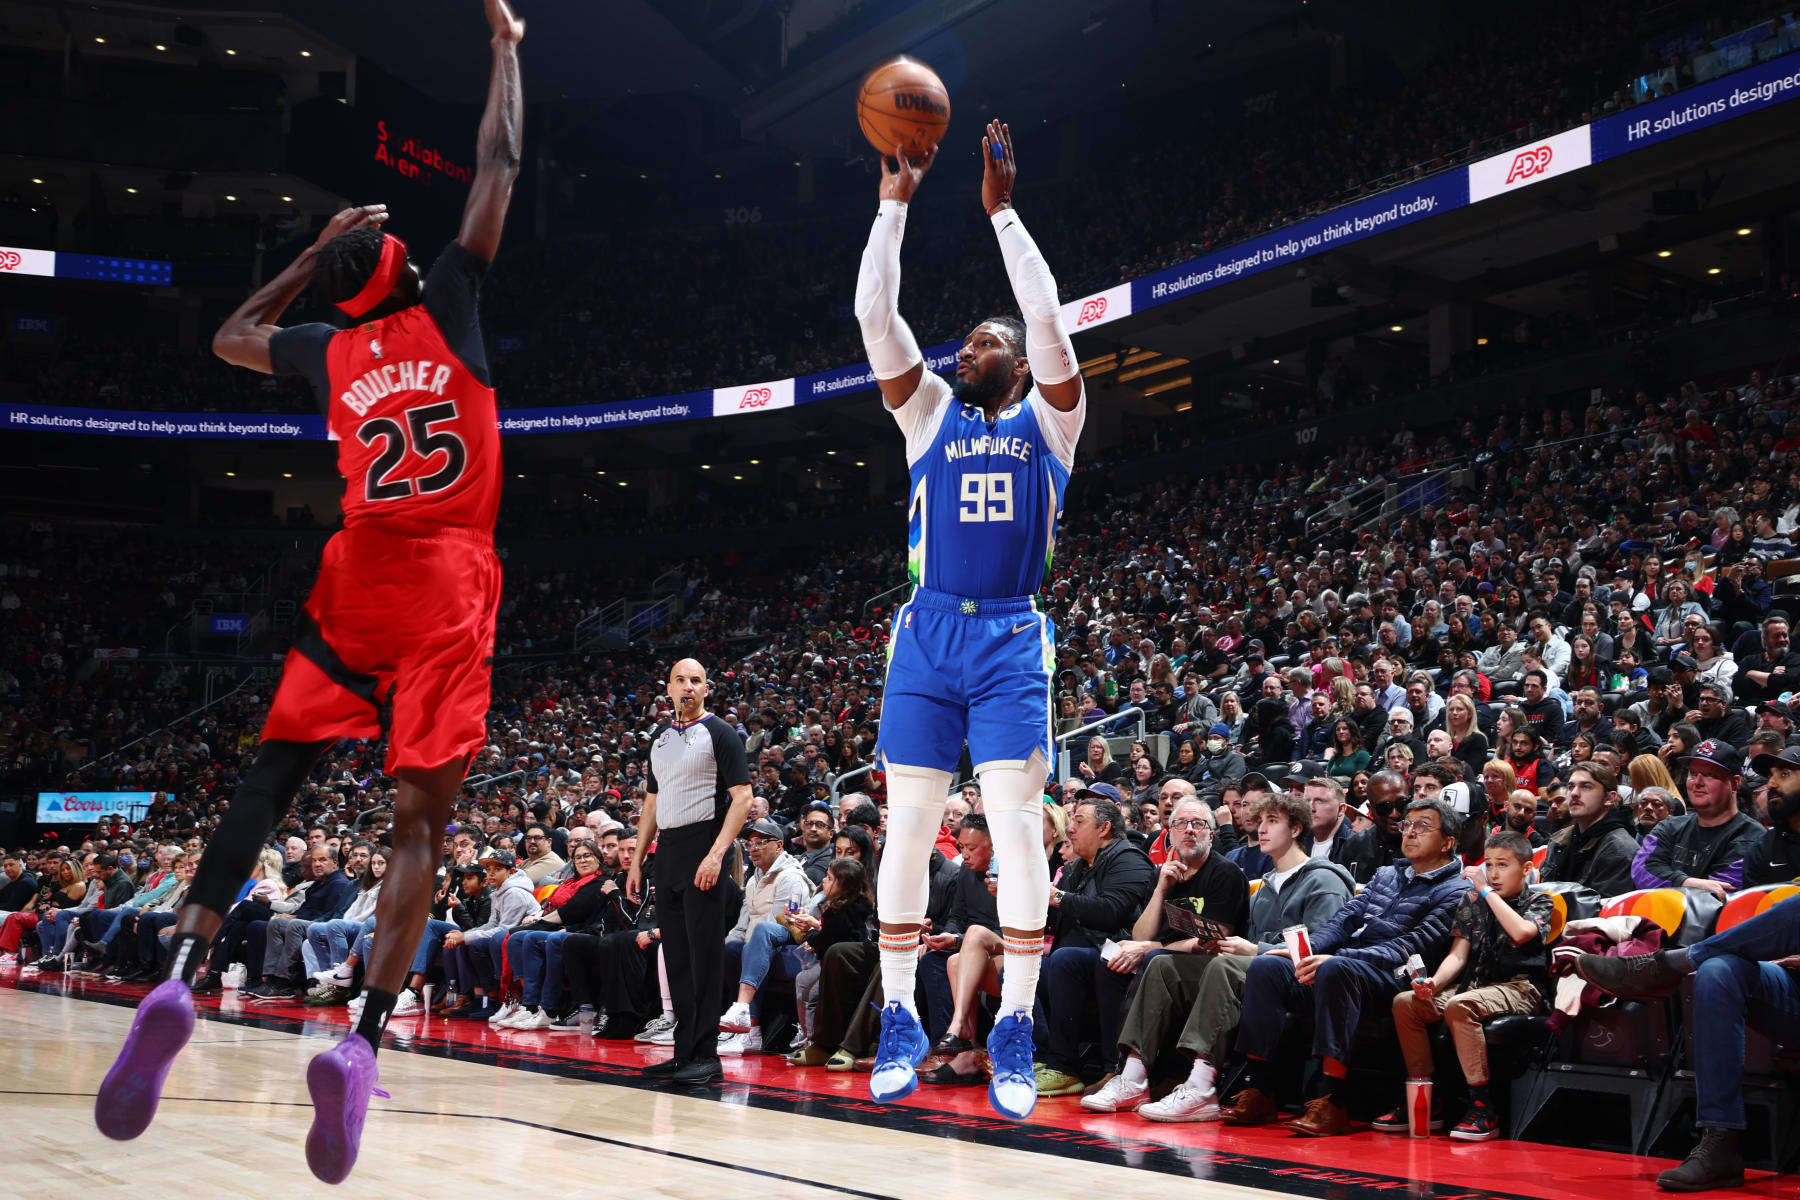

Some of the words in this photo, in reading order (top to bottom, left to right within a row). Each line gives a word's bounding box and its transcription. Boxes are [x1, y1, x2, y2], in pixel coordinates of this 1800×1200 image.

[1628, 119, 1651, 142] HR
[1654, 98, 1727, 133] solutions
[1505, 145, 1553, 185] ADP
[723, 206, 762, 225] 306
[1152, 282, 1168, 299] HR
[1168, 270, 1214, 294] solutions
[1214, 250, 1260, 275] designed
[1262, 249, 1274, 262] to
[1275, 239, 1299, 257] help
[1300, 234, 1321, 253] you
[1323, 220, 1352, 242] think
[1354, 203, 1398, 231] beyond
[1400, 195, 1438, 217] today.
[1077, 296, 1108, 326] ADP
[18, 318, 48, 333] IBM
[937, 354, 955, 369] you
[341, 360, 452, 418] BOUCHER
[812, 381, 826, 394] HR
[827, 371, 865, 391] solutions
[739, 387, 772, 409] ADP
[10, 411, 29, 424] HR
[30, 413, 84, 428] solutions
[85, 416, 136, 433] designed
[137, 420, 150, 431] to
[151, 420, 176, 435] help
[176, 423, 197, 435] you
[199, 421, 227, 433] think
[228, 421, 268, 435] beyond
[269, 422, 303, 436] today.
[504, 415, 549, 431] designed
[550, 416, 561, 427] to
[562, 414, 584, 428] help
[584, 414, 602, 427] you
[603, 409, 628, 422] think
[628, 405, 661, 422] beyond
[662, 403, 691, 417] today.
[1296, 426, 1319, 445] 107
[356, 400, 468, 502] 25
[960, 472, 1014, 522] 99
[216, 618, 243, 631] IBM
[64, 795, 103, 812] Coors
